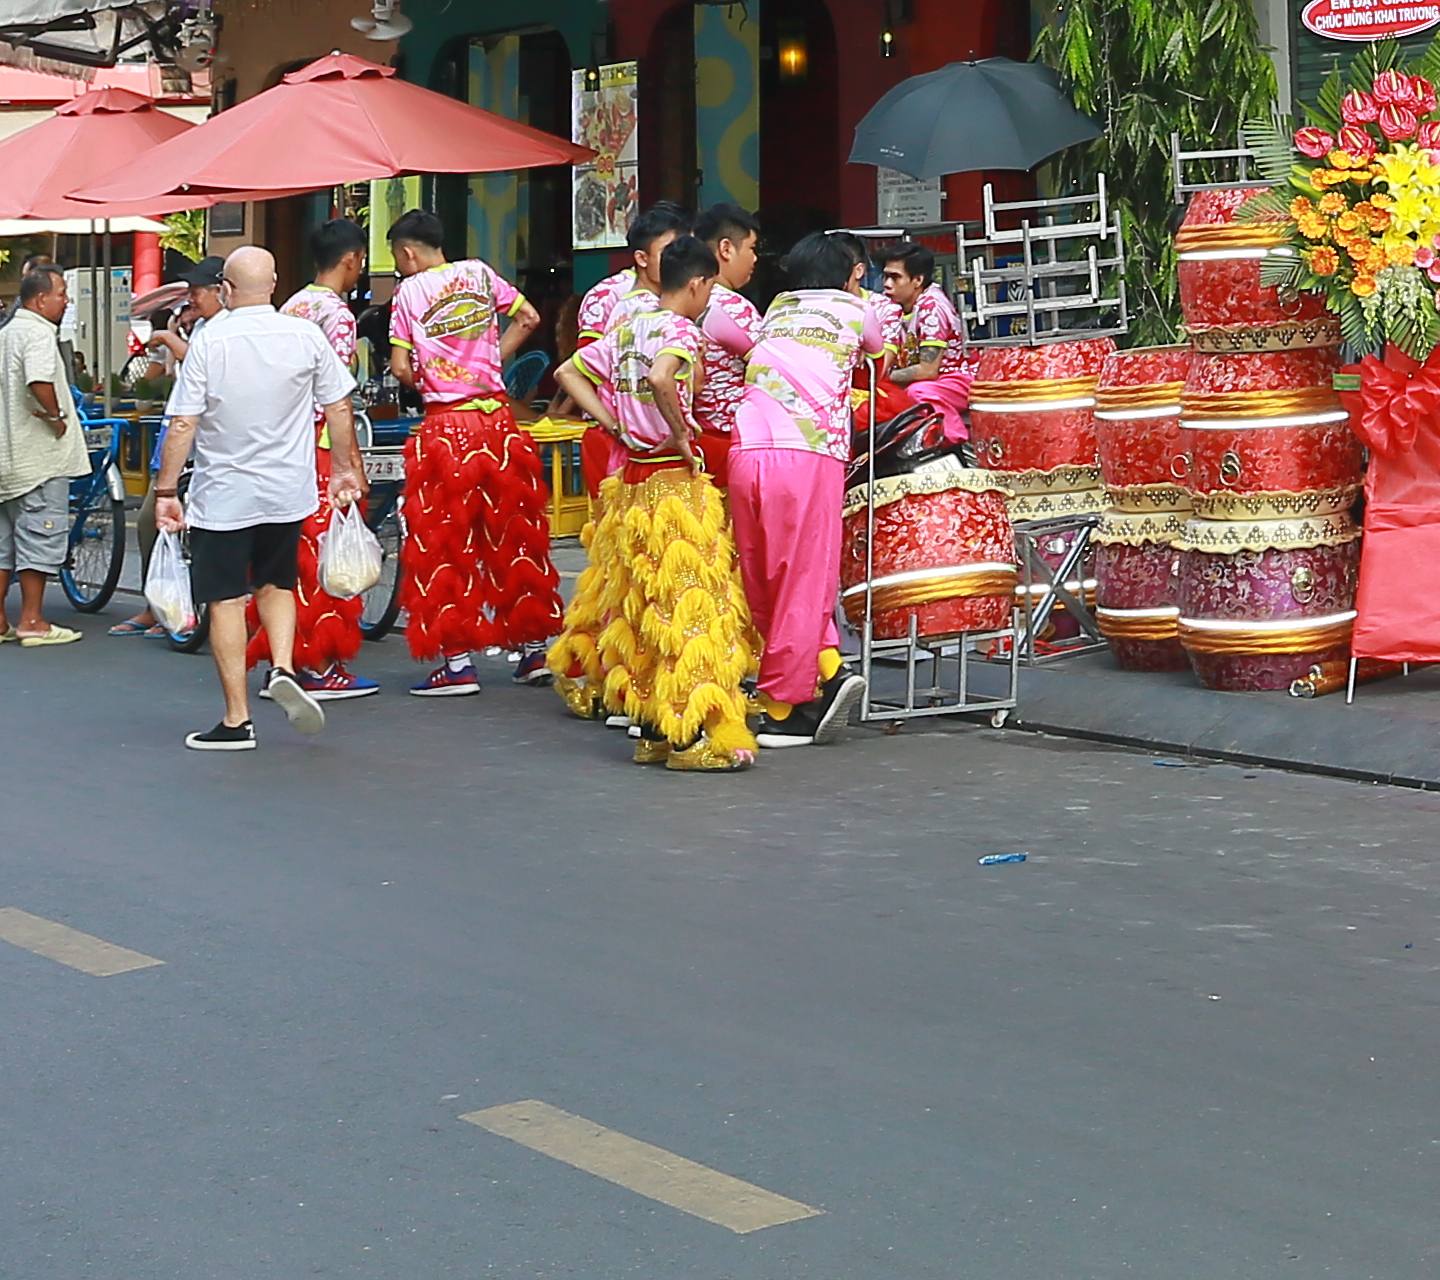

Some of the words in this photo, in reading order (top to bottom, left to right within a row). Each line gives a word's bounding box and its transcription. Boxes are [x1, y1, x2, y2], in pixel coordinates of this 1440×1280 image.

[1315, 9, 1344, 31] CHÚC
[1344, 7, 1374, 28] MỪNG
[1374, 7, 1399, 25] KHAI
